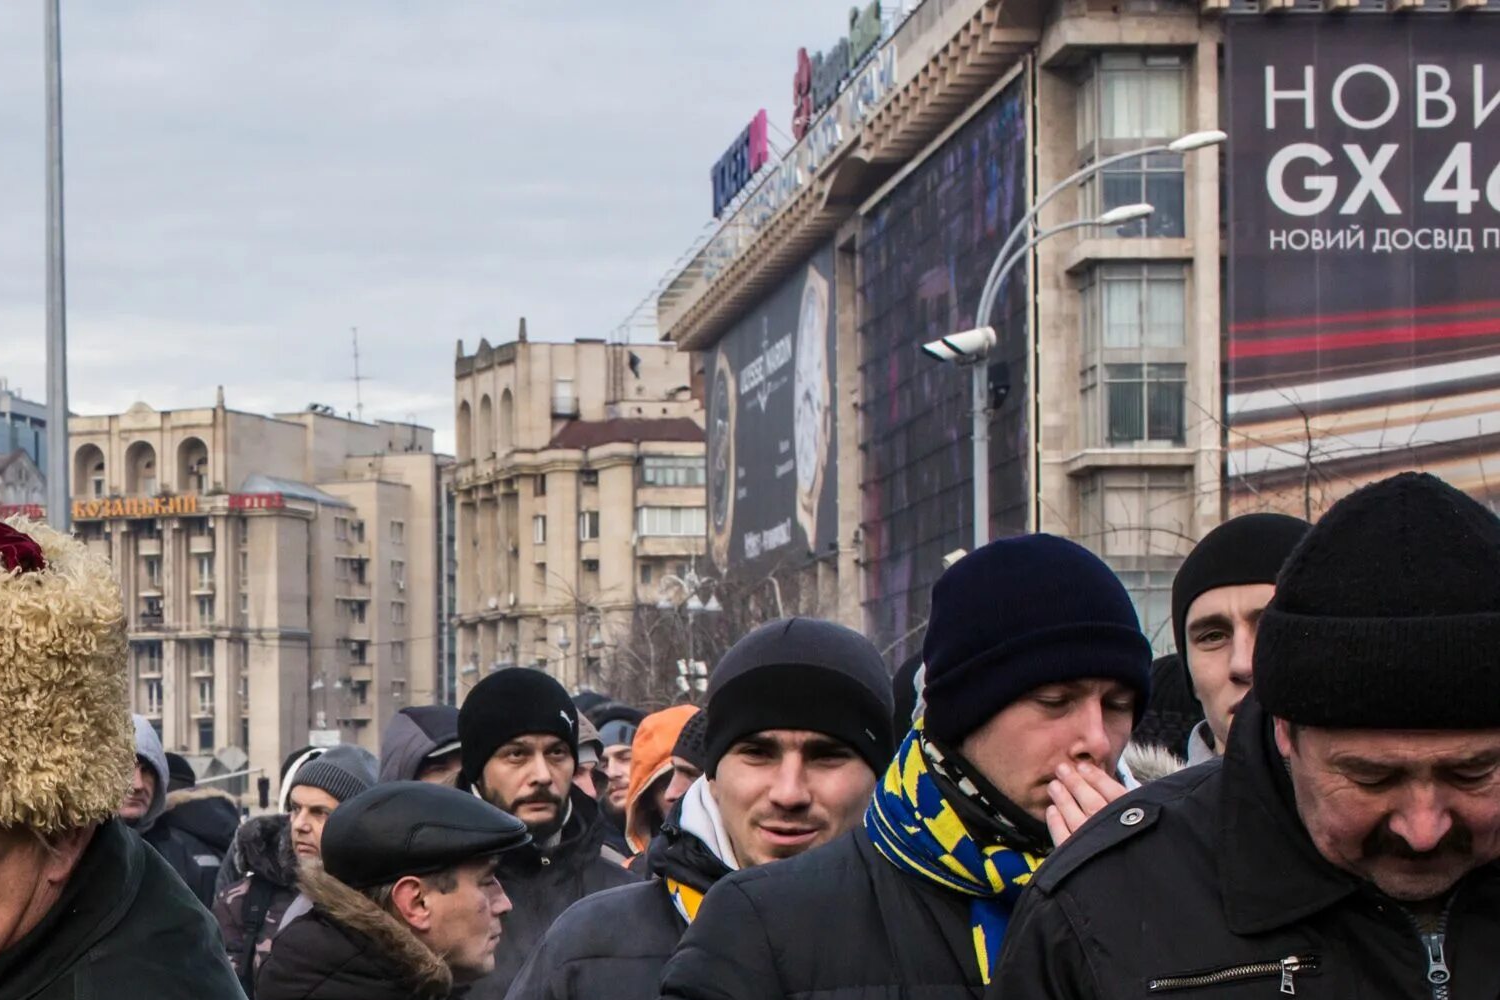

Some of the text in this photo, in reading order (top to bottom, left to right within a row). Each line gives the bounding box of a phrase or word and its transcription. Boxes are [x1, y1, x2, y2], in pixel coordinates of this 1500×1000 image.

[1266, 142, 1500, 216] GX 4
[1270, 225, 1364, 250] НОВИЙ
[1372, 228, 1474, 252] ДОСВІД
[73, 493, 197, 518] КОЗАЦЬКИЙ
